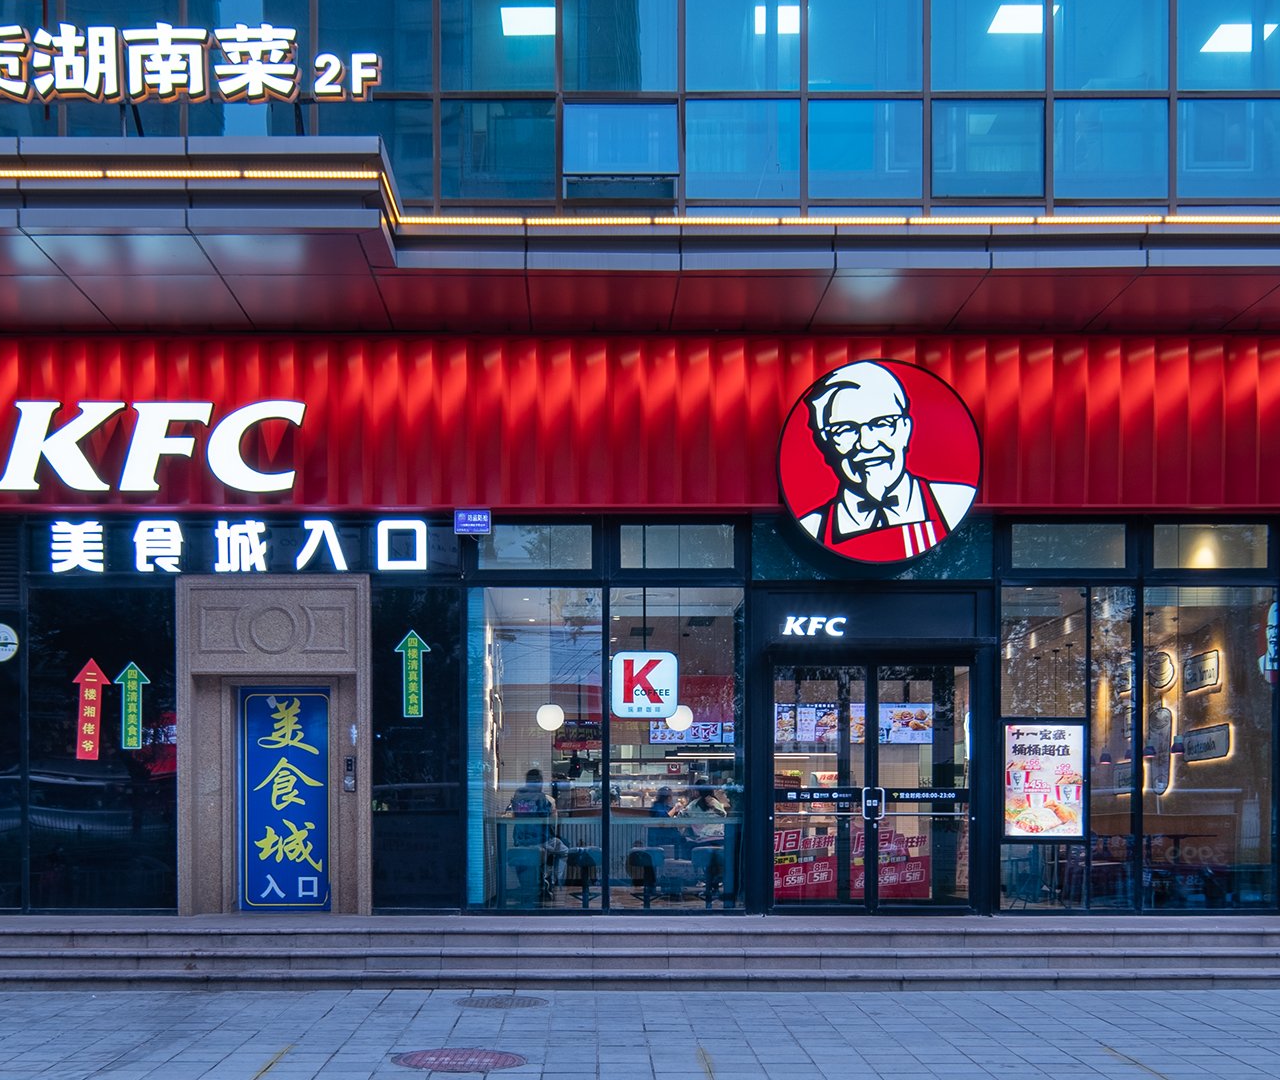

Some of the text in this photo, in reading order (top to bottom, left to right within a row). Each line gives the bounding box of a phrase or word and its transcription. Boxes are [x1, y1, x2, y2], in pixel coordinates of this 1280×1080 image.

[50, 519, 428, 573] 美食城入口
[781, 615, 848, 637] KFC
[407, 637, 420, 715] 四楼清真美食城
[622, 659, 664, 704] K
[634, 688, 671, 697] COFFEE
[81, 672, 98, 752] 二楼湘佬爷
[253, 697, 325, 873] 美食城
[260, 874, 319, 899] 入口
